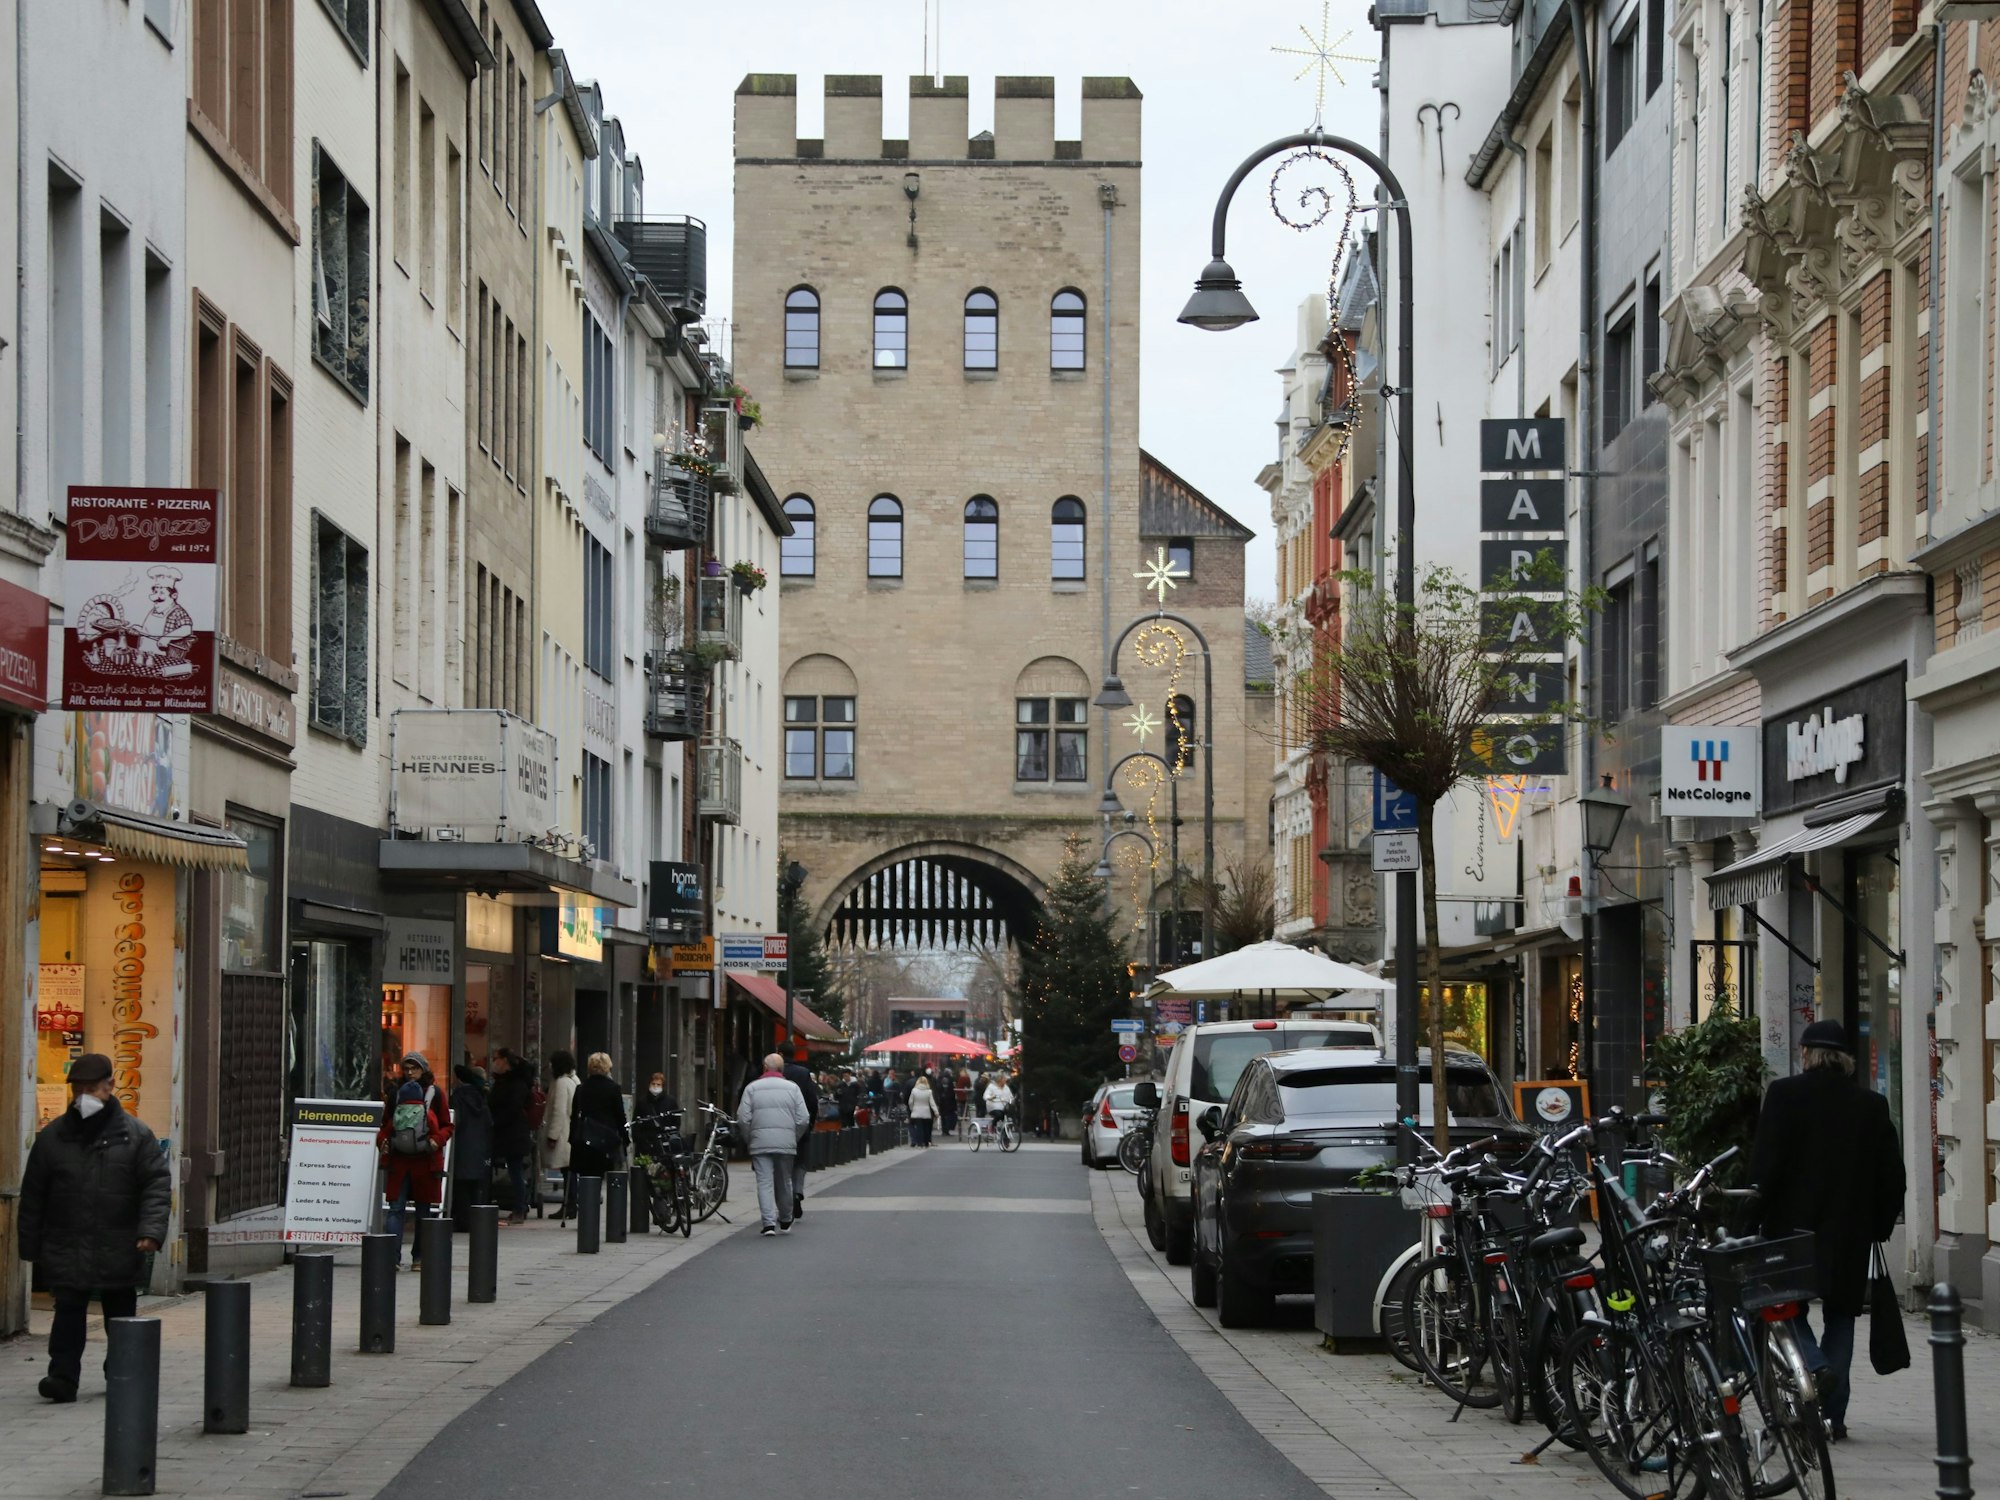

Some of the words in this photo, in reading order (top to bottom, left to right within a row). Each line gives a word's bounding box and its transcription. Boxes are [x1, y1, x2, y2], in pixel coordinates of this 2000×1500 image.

[71, 497, 148, 508] RISTORANTE
[157, 500, 211, 510] PIZZERIA
[71, 514, 118, 543] Del
[118, 514, 211, 551] Bajazzo
[171, 544, 186, 552] seit
[189, 544, 210, 552] 1974
[1505, 428, 1542, 766] MARANO
[0, 646, 37, 690] PIZZERIA
[69, 695, 86, 705] Alle
[90, 696, 121, 706] Gerichte
[164, 698, 206, 708] Mitnehmen
[233, 683, 263, 726] ESCH
[402, 763, 495, 774] HENNES
[518, 754, 548, 800] HENNES
[1668, 788, 1751, 803] NetCologne
[671, 868, 697, 884] home
[400, 946, 450, 972] HENNES
[298, 1109, 374, 1123] Herrenmode
